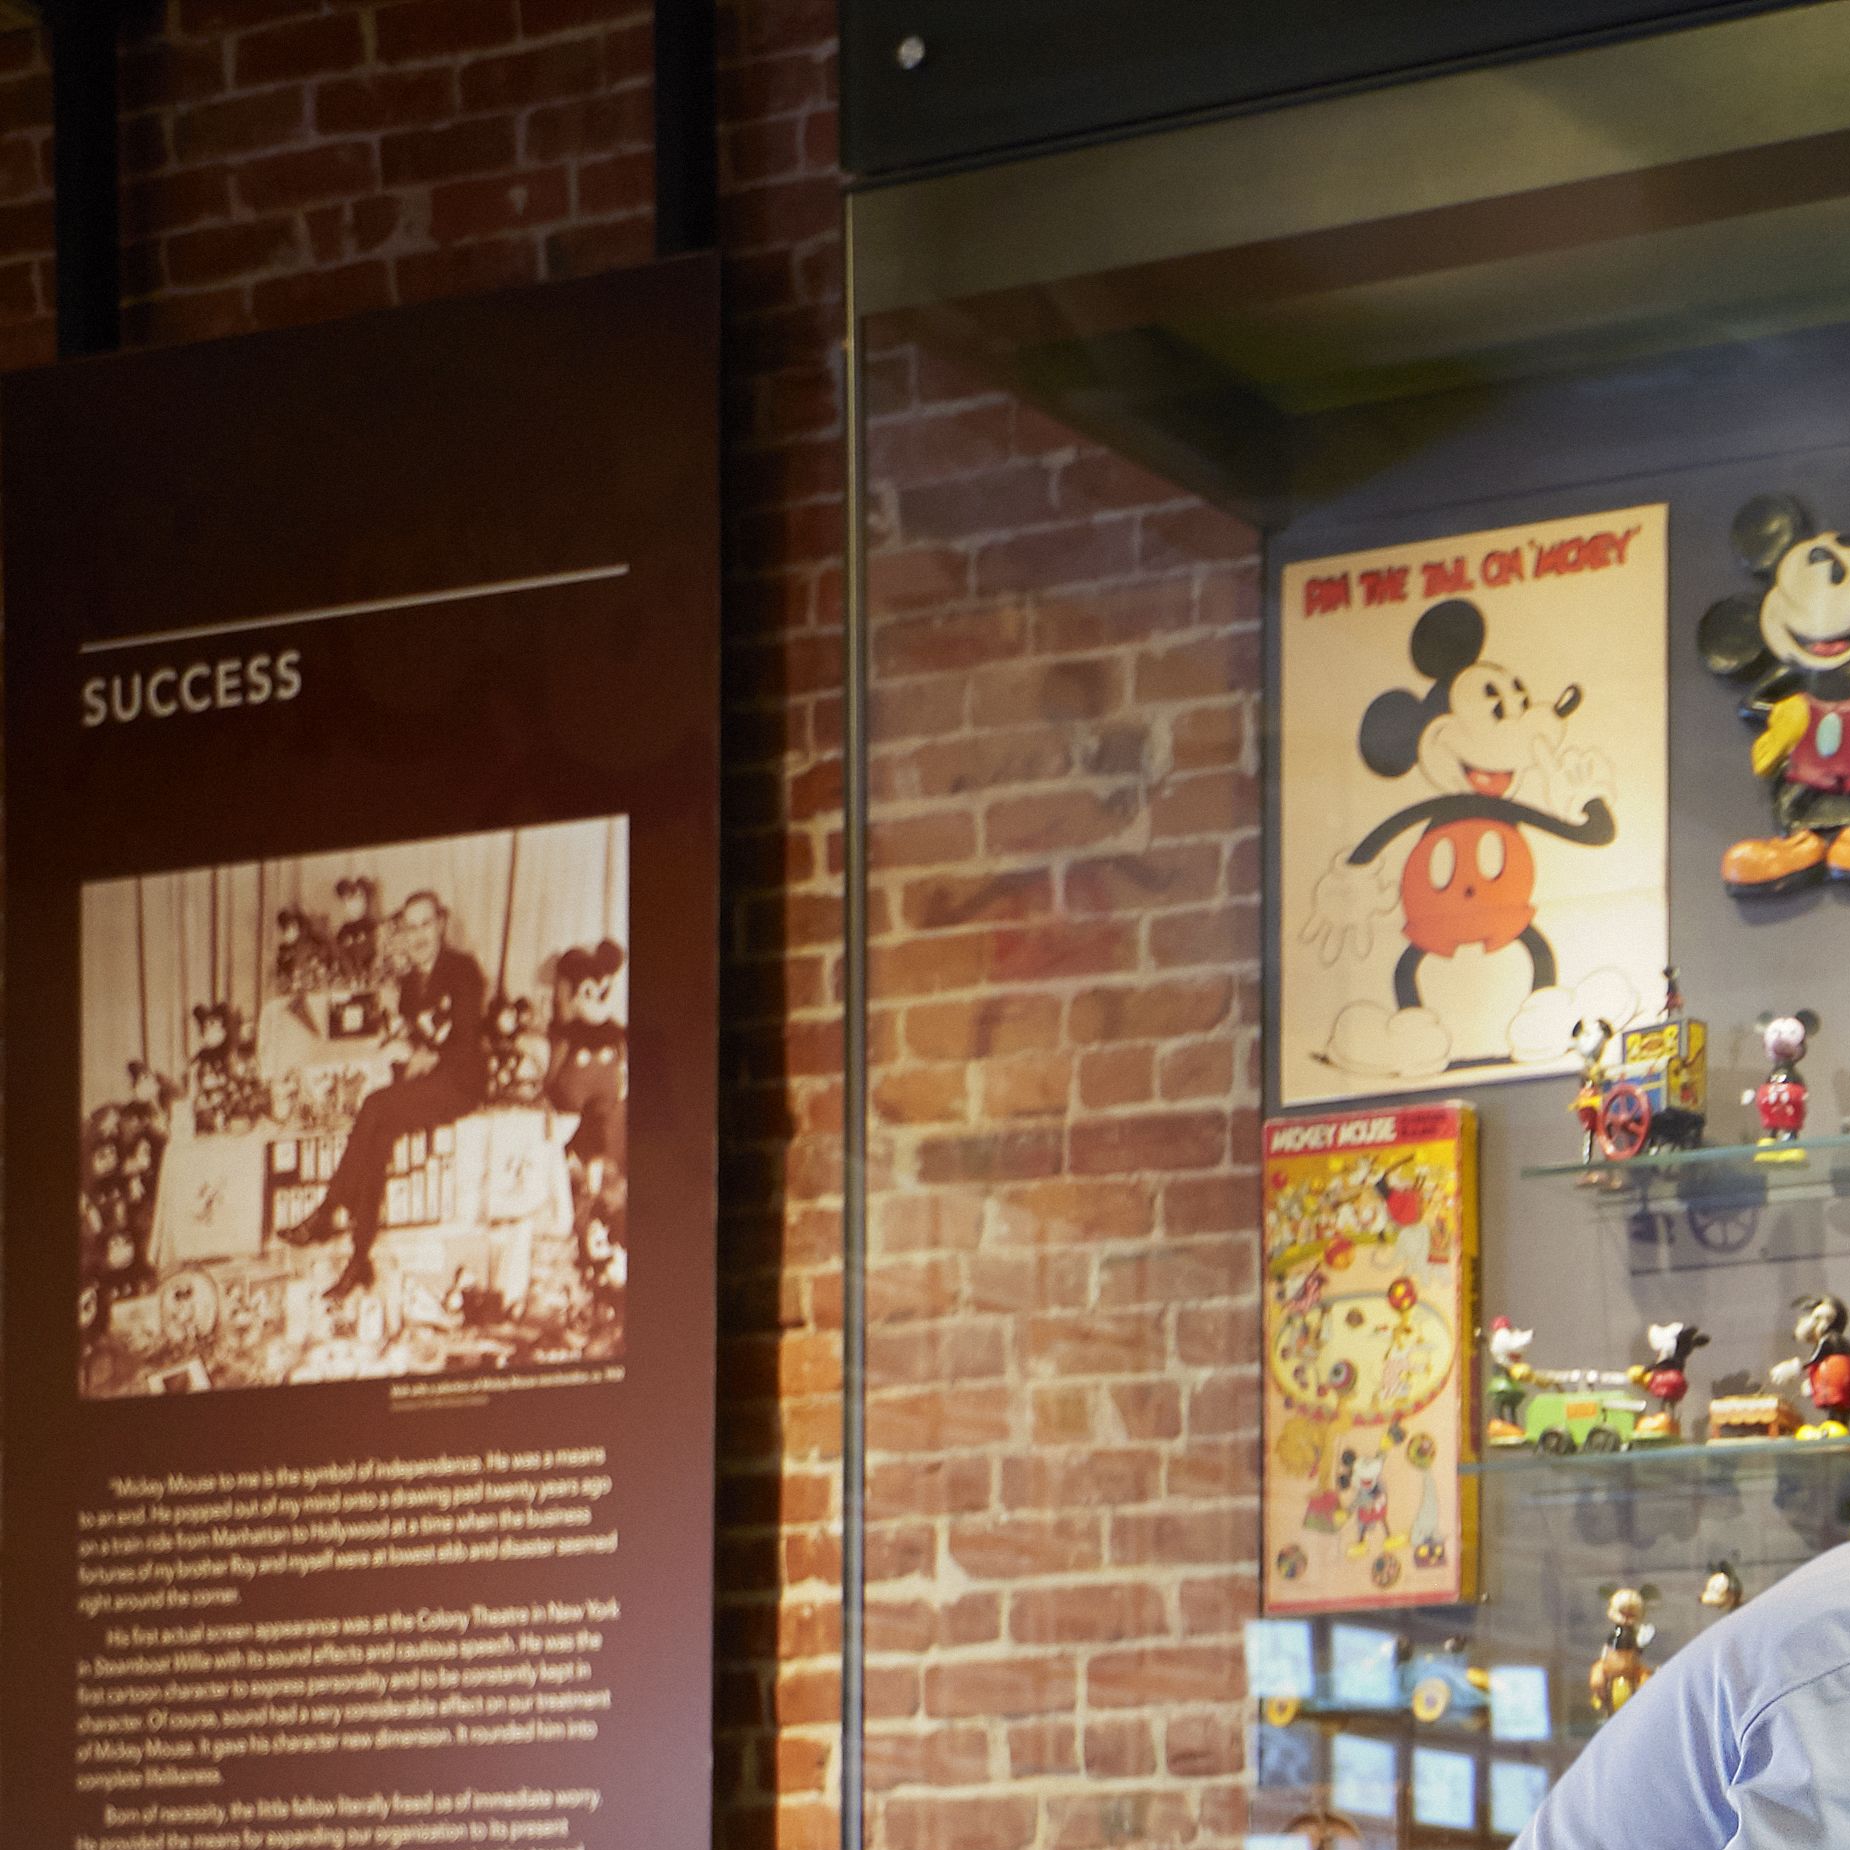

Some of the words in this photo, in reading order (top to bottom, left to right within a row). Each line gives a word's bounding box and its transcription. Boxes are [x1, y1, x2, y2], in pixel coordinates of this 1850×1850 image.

[1304, 573, 1351, 619] PIN
[1357, 565, 1410, 606] THE
[1480, 546, 1525, 588] ON
[82, 648, 302, 728] SUCCESS
[1270, 1124, 1337, 1154] MICKEY
[1337, 1117, 1398, 1147] MOUSE
